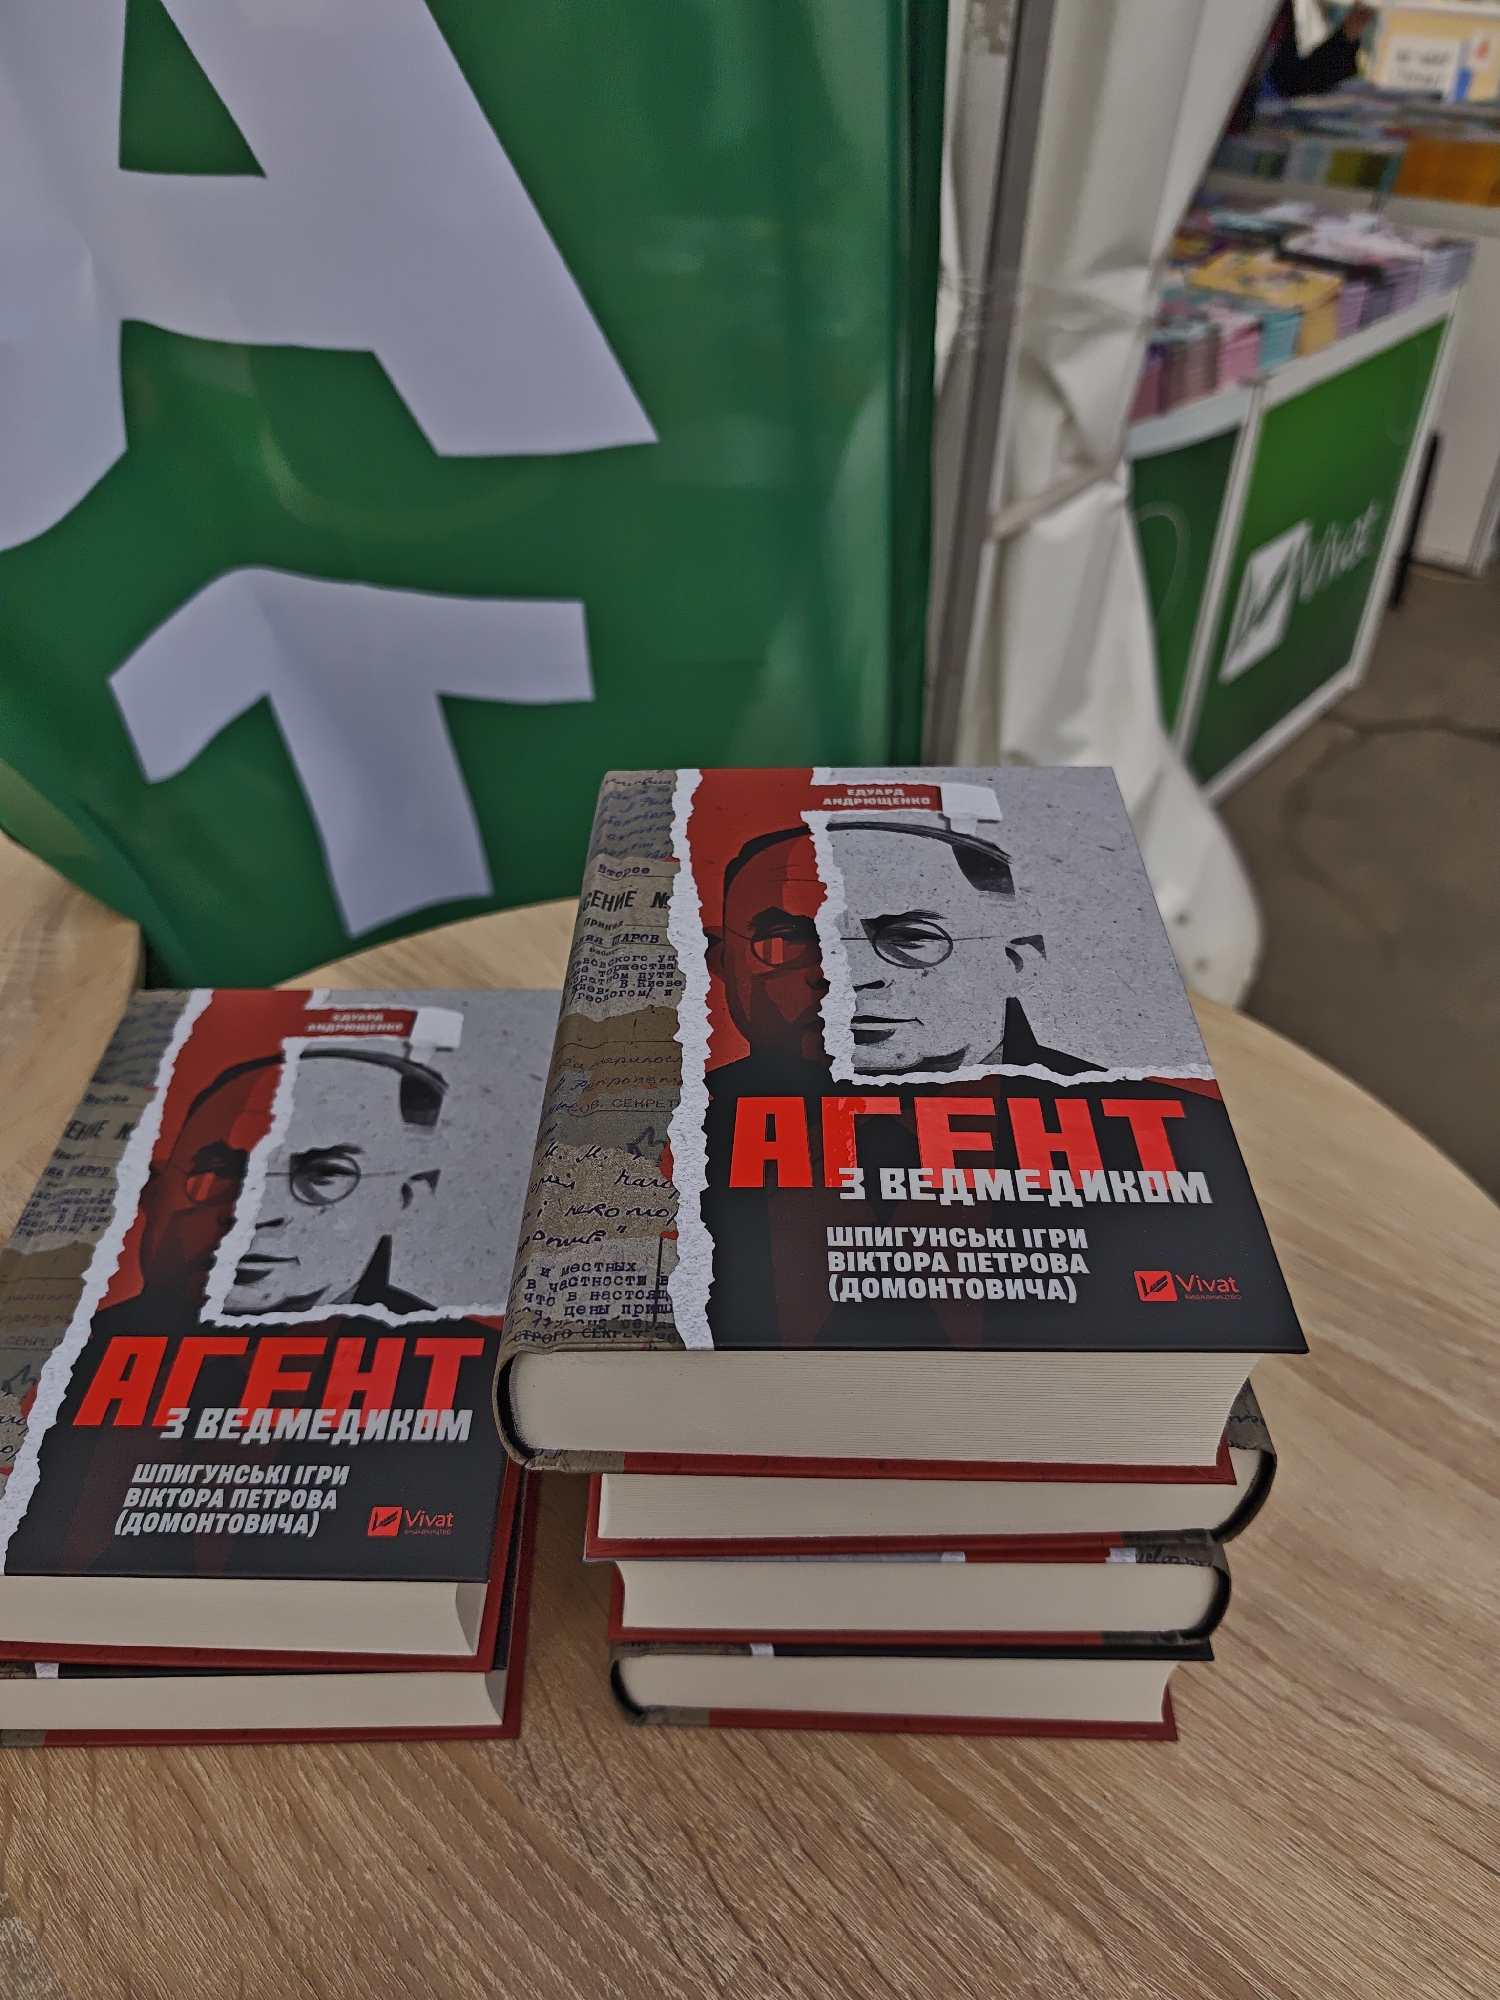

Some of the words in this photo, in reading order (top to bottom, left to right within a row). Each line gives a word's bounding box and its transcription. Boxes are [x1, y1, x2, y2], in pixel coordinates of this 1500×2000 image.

[823, 797, 931, 806] АНДРЮЩЕНКО
[847, 788, 905, 797] ЕДУАРД
[597, 864, 650, 879] Второе
[612, 933, 660, 947] ШАРОВ
[729, 1096, 1187, 1190] АГЕНТ
[839, 1167, 866, 1200] З
[879, 1168, 1213, 1207] ВЕДМЕДИКОМ
[826, 1226, 1015, 1249] ШПИГУНСЬКІ
[1023, 1228, 1089, 1250] ІГРИ
[561, 1261, 637, 1277] местных
[828, 1251, 952, 1274] ВІКТОРА
[957, 1252, 1090, 1275] ПЕТРОВА
[549, 1275, 647, 1292] частности
[828, 1275, 1078, 1304] (ДОМОНТОВИЧА)
[1174, 1274, 1240, 1293] Vivat
[73, 1336, 485, 1427] АГЕНТ
[160, 1407, 190, 1440] З
[194, 1407, 472, 1446] ВЕДМЕДИКОМ
[131, 1464, 291, 1485] ШПИГУНСЬКІ
[294, 1465, 350, 1486] ІГРИ
[123, 1487, 224, 1509] ВІКТОРА
[230, 1488, 338, 1511] ПЕТРОВА
[114, 1510, 320, 1538] (ДОМОНТОВИЧА)
[404, 1509, 455, 1528] Vivat
